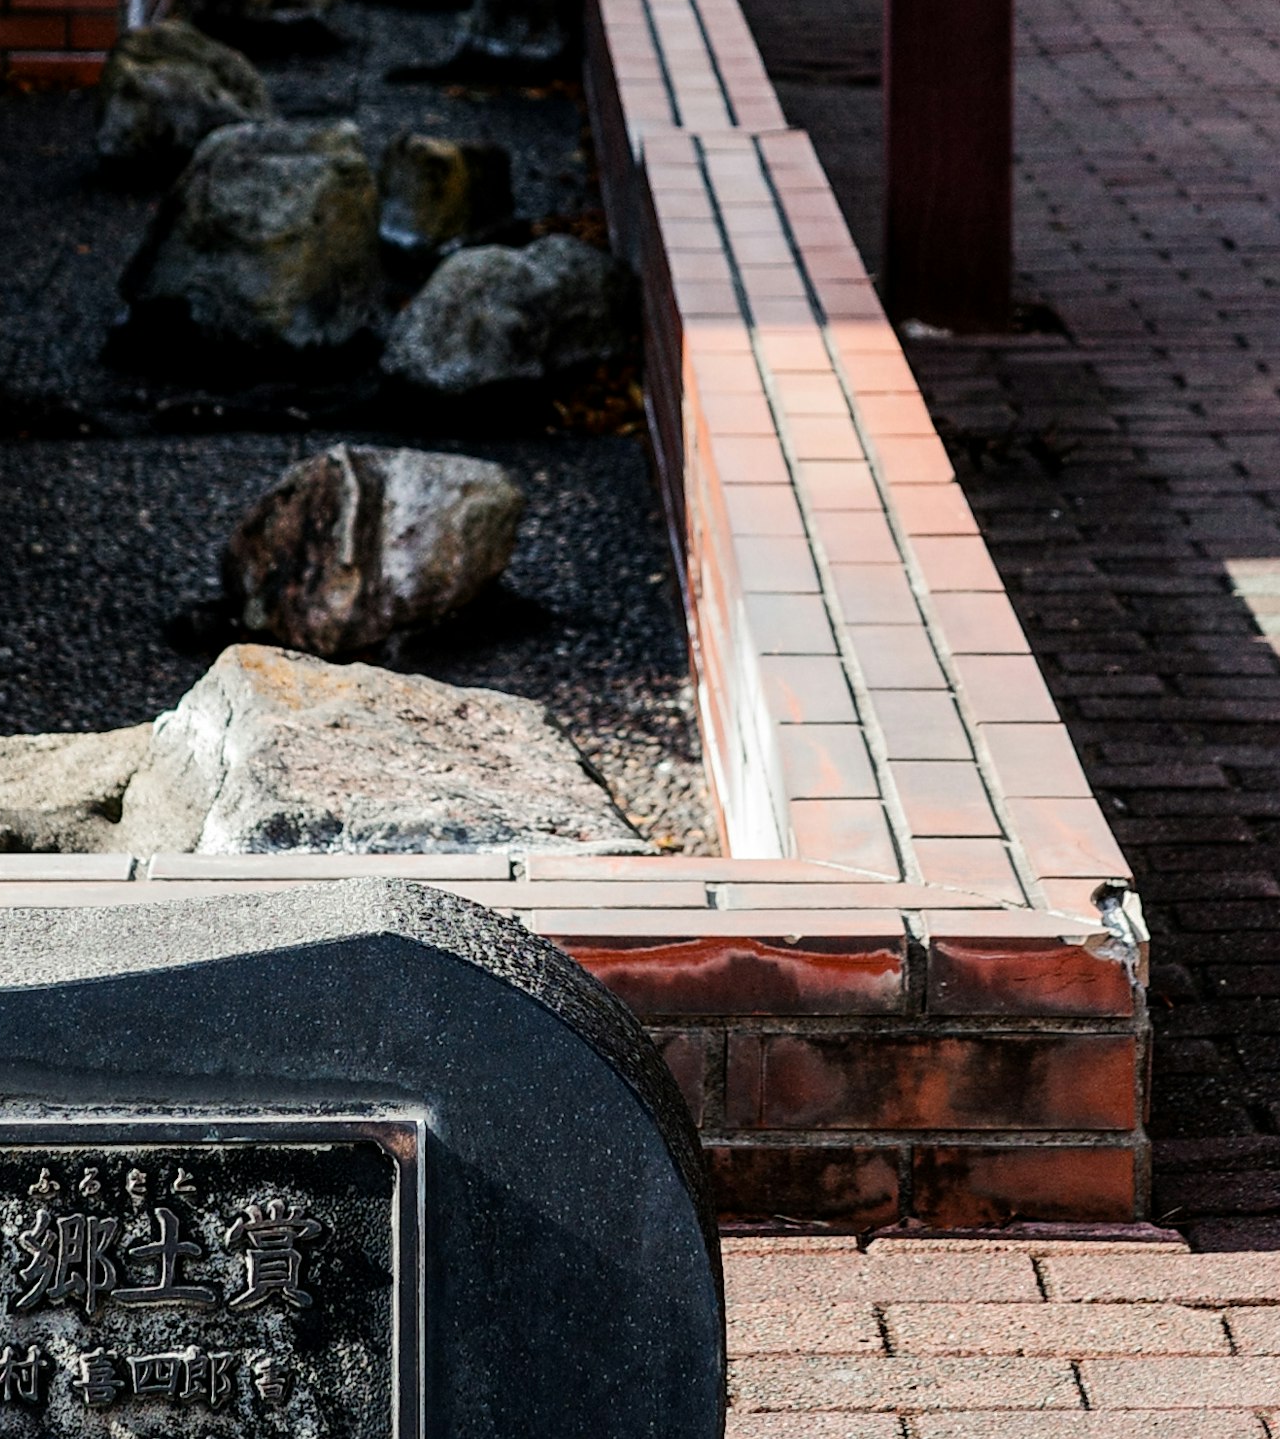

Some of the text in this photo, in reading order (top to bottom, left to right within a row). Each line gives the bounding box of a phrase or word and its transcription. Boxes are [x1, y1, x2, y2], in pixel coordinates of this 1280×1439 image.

[28, 1167, 198, 1197] ふるさと
[73, 1345, 239, 1408] 喜四郎
